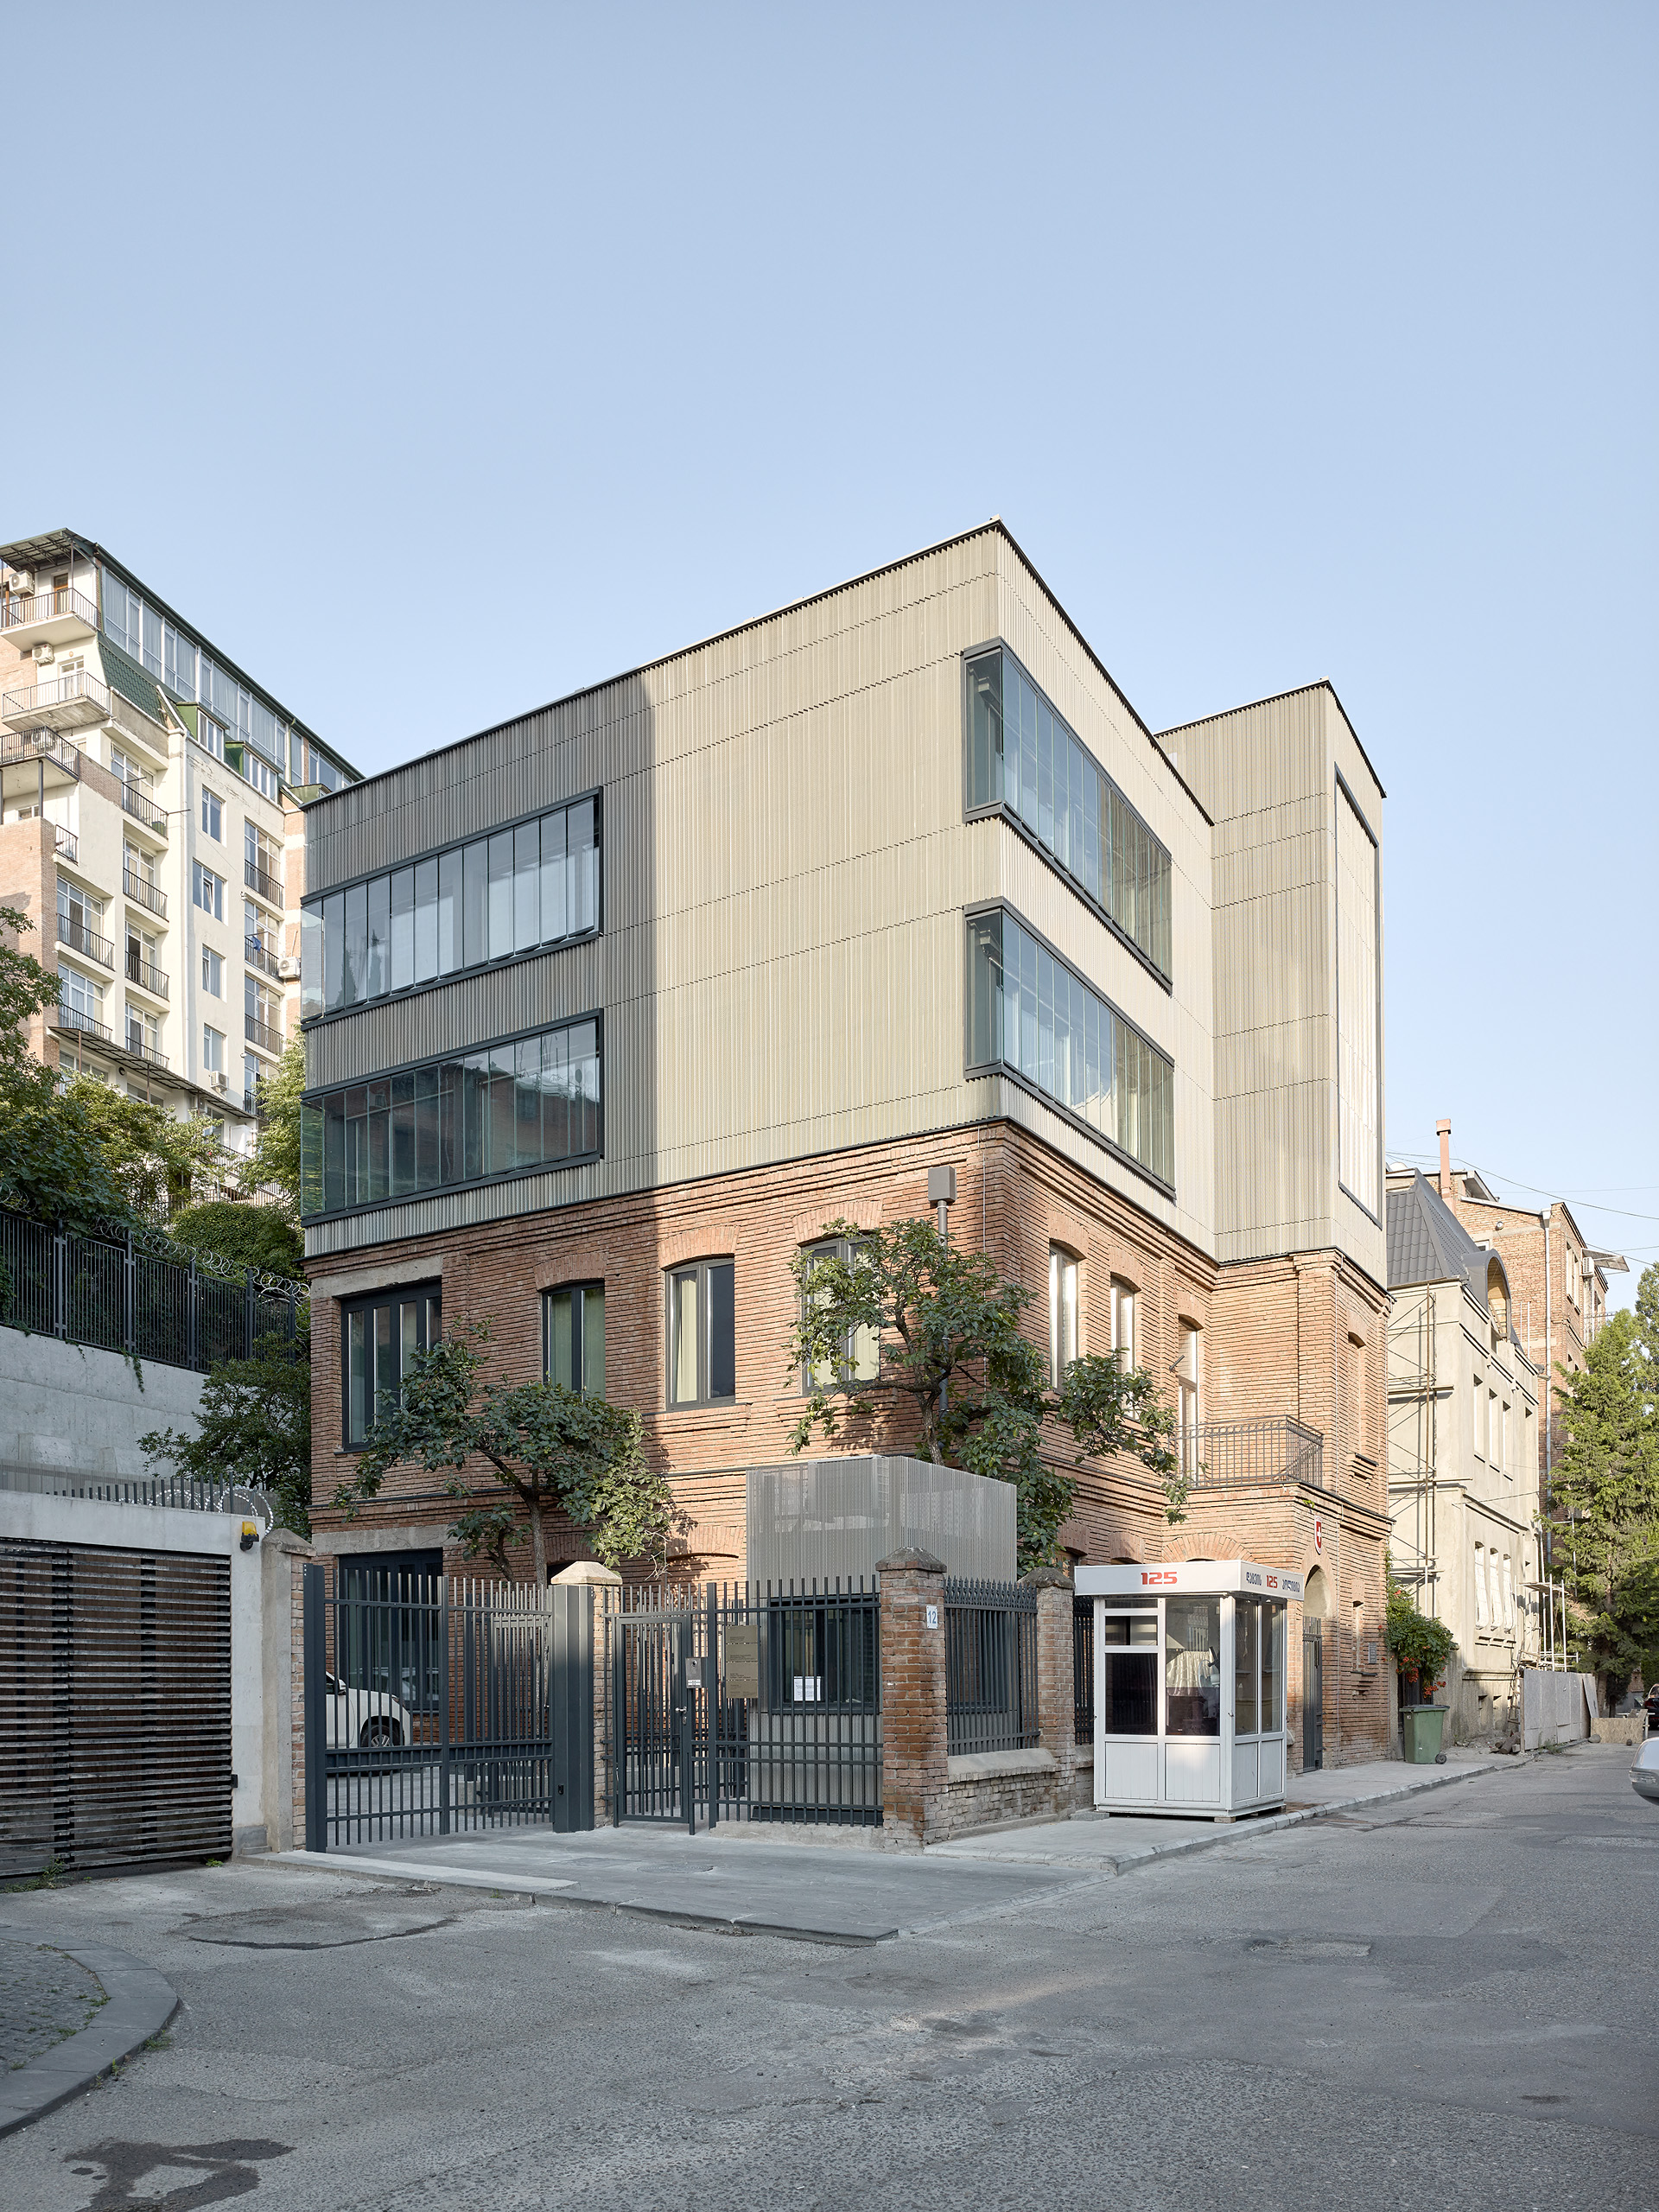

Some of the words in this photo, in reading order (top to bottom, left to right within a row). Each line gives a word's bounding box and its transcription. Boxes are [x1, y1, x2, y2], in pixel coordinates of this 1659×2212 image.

[1141, 1572, 1178, 1585] 125
[1266, 1575, 1278, 1588] 125
[928, 1611, 937, 1624] 12
